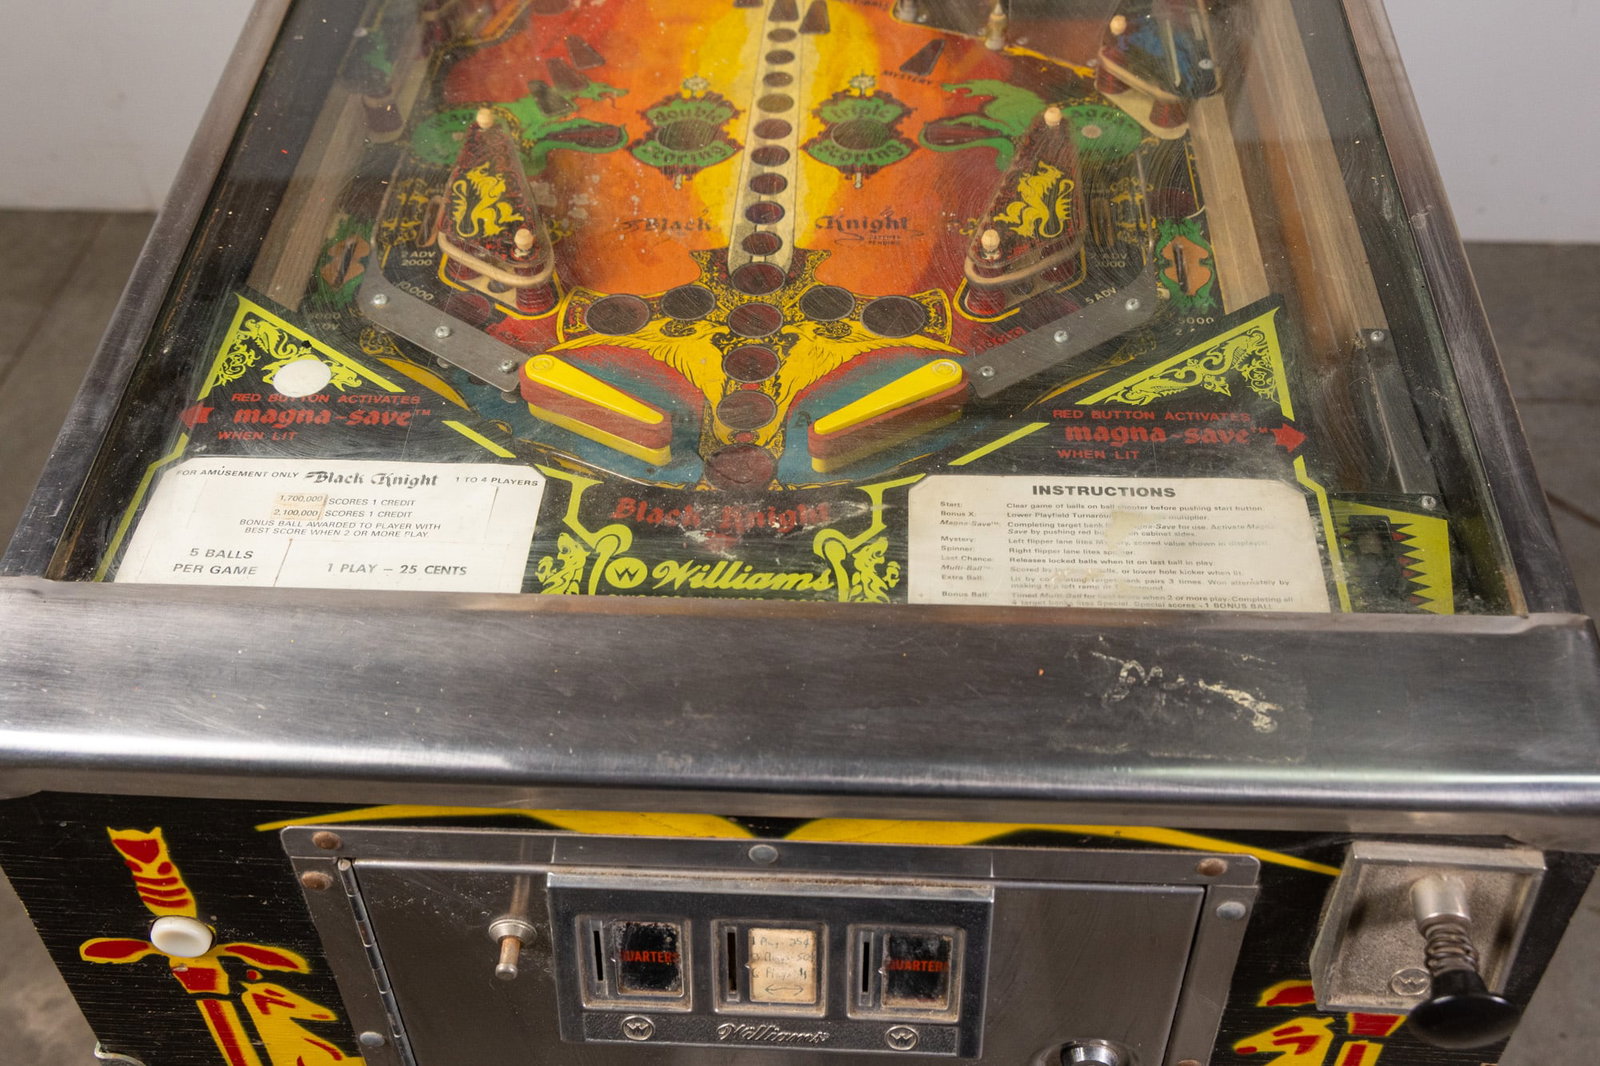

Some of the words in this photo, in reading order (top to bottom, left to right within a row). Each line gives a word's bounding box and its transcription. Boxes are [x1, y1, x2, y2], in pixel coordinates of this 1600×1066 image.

[231, 393, 262, 402] RED
[268, 394, 330, 403] BUTTON
[338, 395, 421, 405] ACTIVATES
[1052, 409, 1084, 419] RED
[1091, 410, 1155, 420] BUTTON
[1164, 411, 1250, 422] ACTIVATES
[217, 431, 267, 441] WHEN
[272, 432, 298, 441] LIT
[1057, 449, 1106, 459] WHEN
[1114, 450, 1140, 460] LIT
[200, 469, 267, 477] AMUSEMENT
[305, 470, 364, 484] Black
[371, 472, 439, 489] Knight
[490, 477, 539, 486] PLAYERS
[1032, 485, 1177, 497] INSTRUCTIONS
[328, 498, 369, 506] SCORES
[610, 497, 701, 528] Black
[239, 518, 275, 526] BONUS
[278, 519, 302, 527] BALL
[306, 521, 356, 529] AWARDED
[359, 521, 373, 529] TO
[376, 522, 417, 530] PLAYER
[245, 526, 270, 534] BEST
[273, 527, 307, 535] SCORE
[189, 548, 199, 556] 5
[205, 549, 254, 559] BALLS
[172, 563, 204, 573] PER
[209, 565, 259, 575] GAME
[327, 563, 333, 573] 1
[340, 563, 378, 573] PLAY
[399, 564, 417, 574] 25
[424, 565, 468, 576] CENTS
[652, 559, 835, 592] Williams
[716, 1021, 831, 1044] Williams
